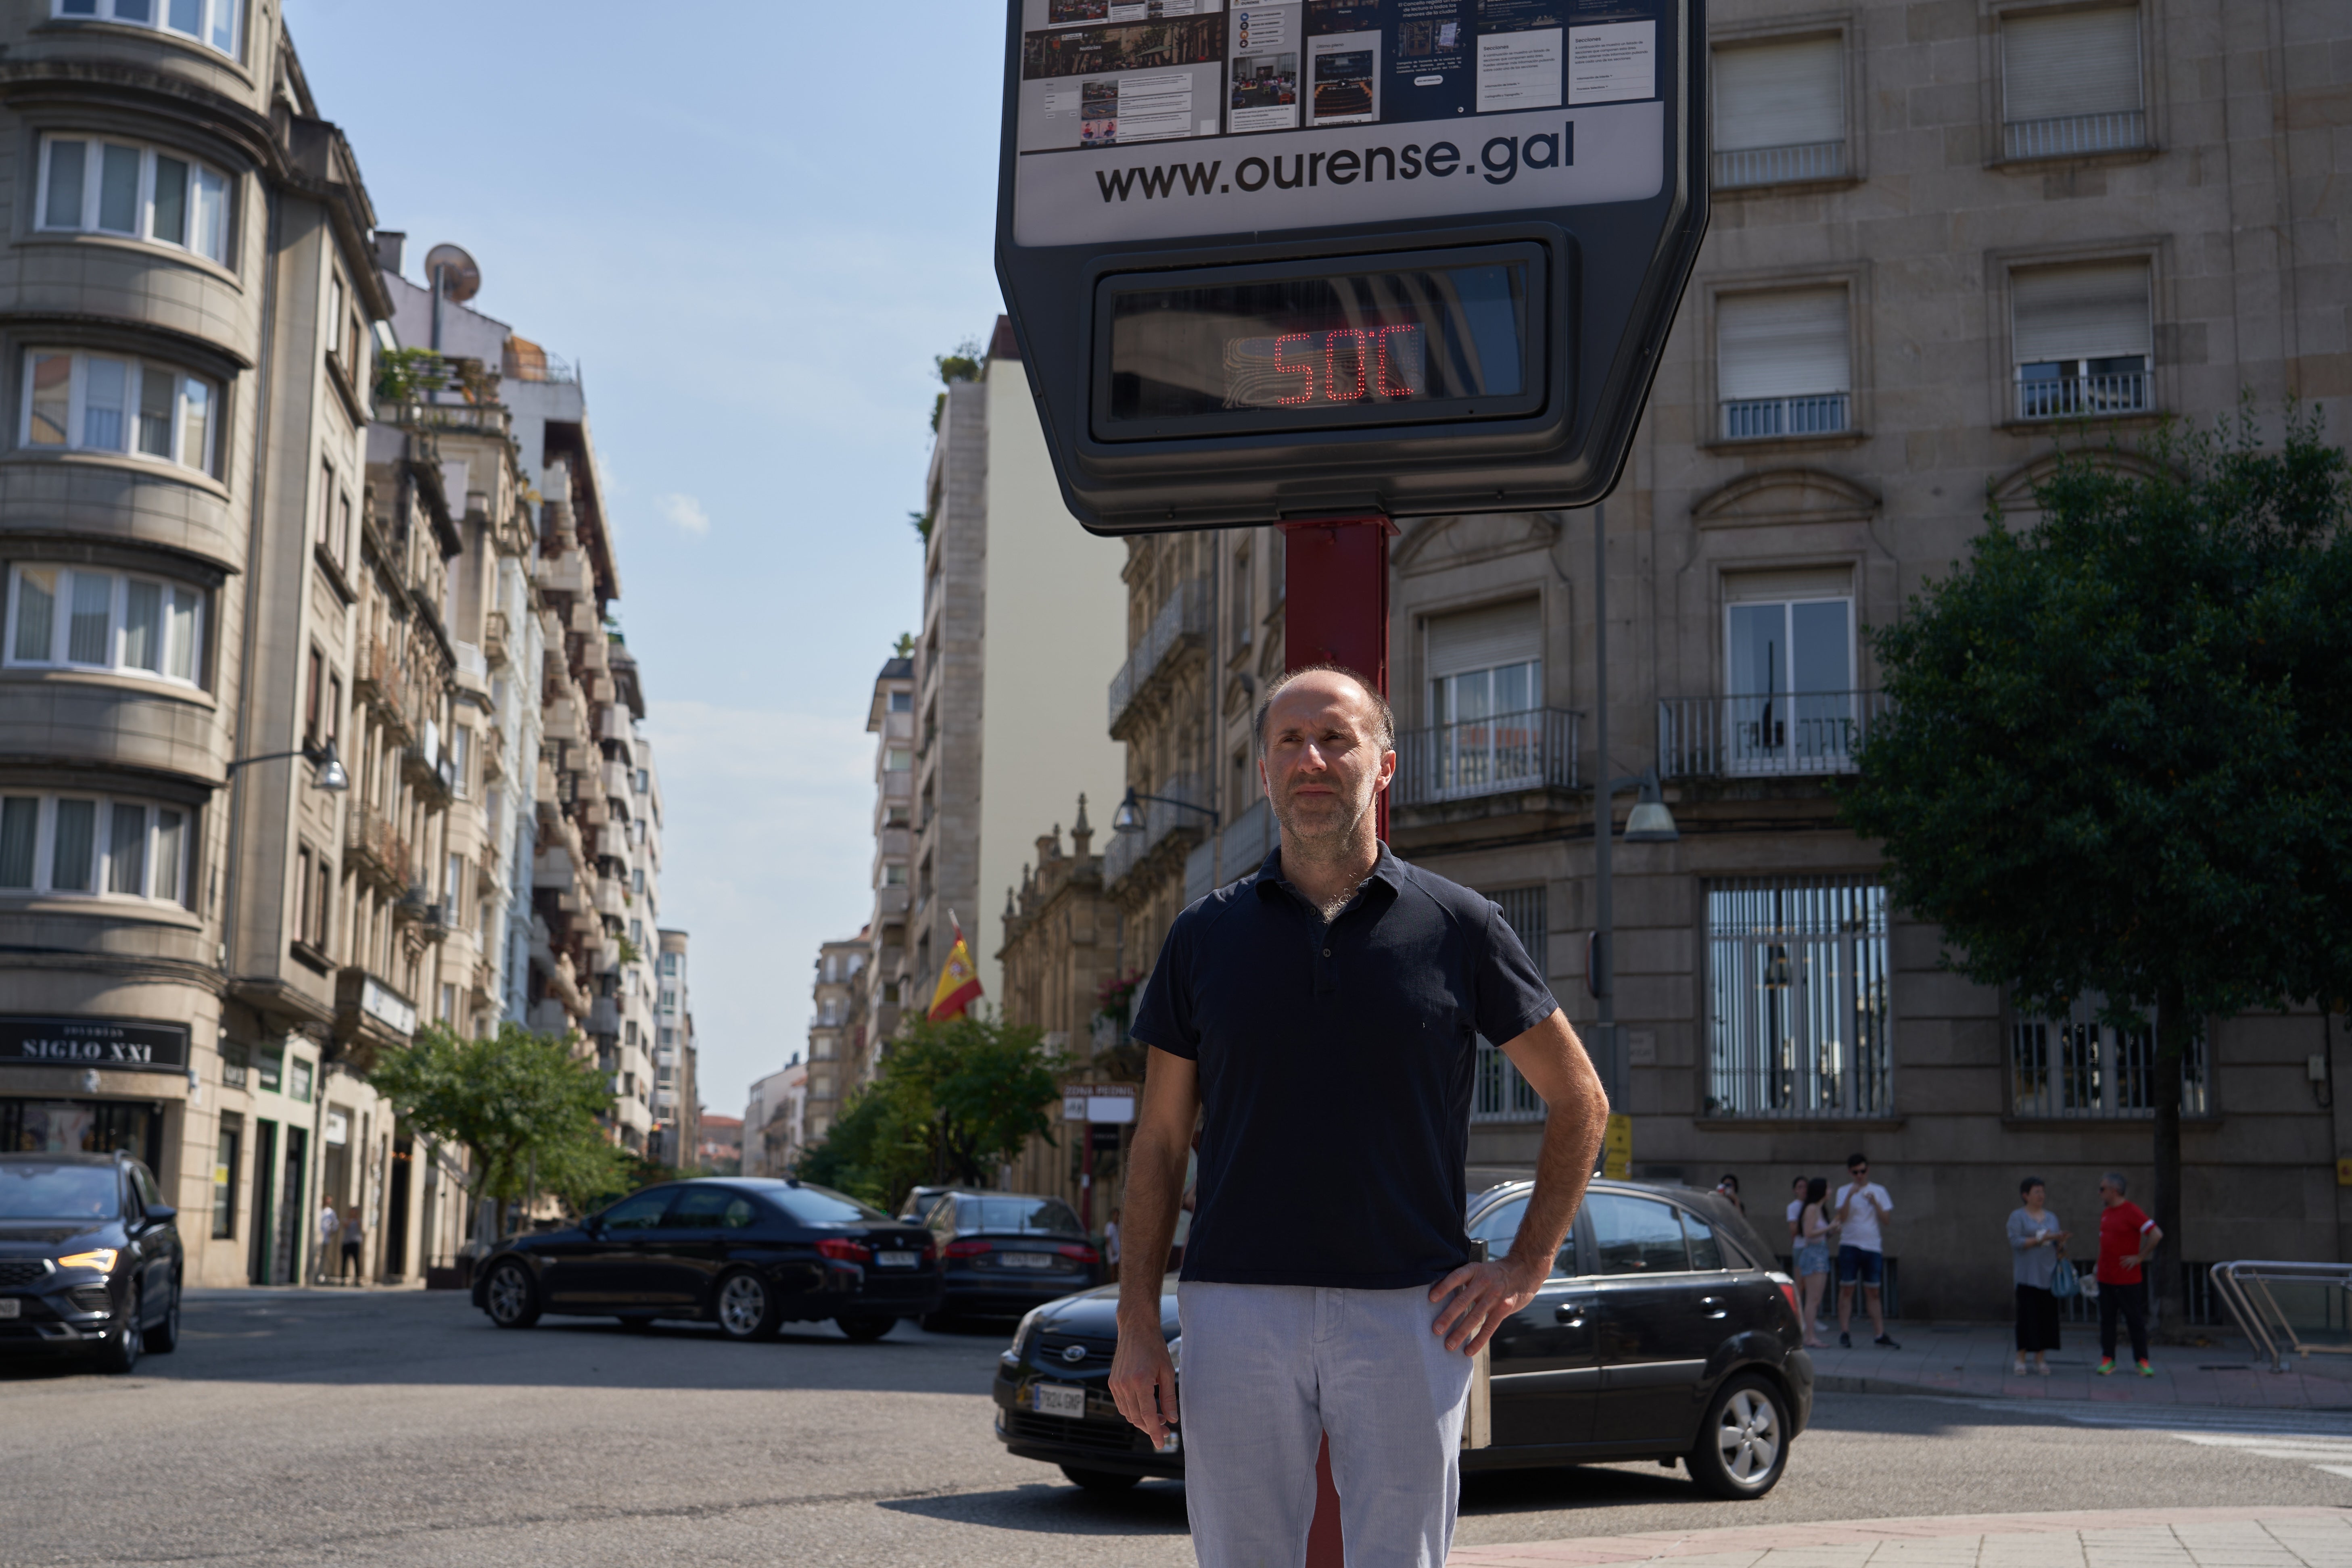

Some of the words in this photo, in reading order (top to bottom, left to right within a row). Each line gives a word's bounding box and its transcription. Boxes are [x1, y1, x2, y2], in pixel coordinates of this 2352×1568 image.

[1096, 121, 1575, 203] www.ourense.gal
[22, 1039, 101, 1060] SIGLO
[110, 1042, 152, 1063] XXI
